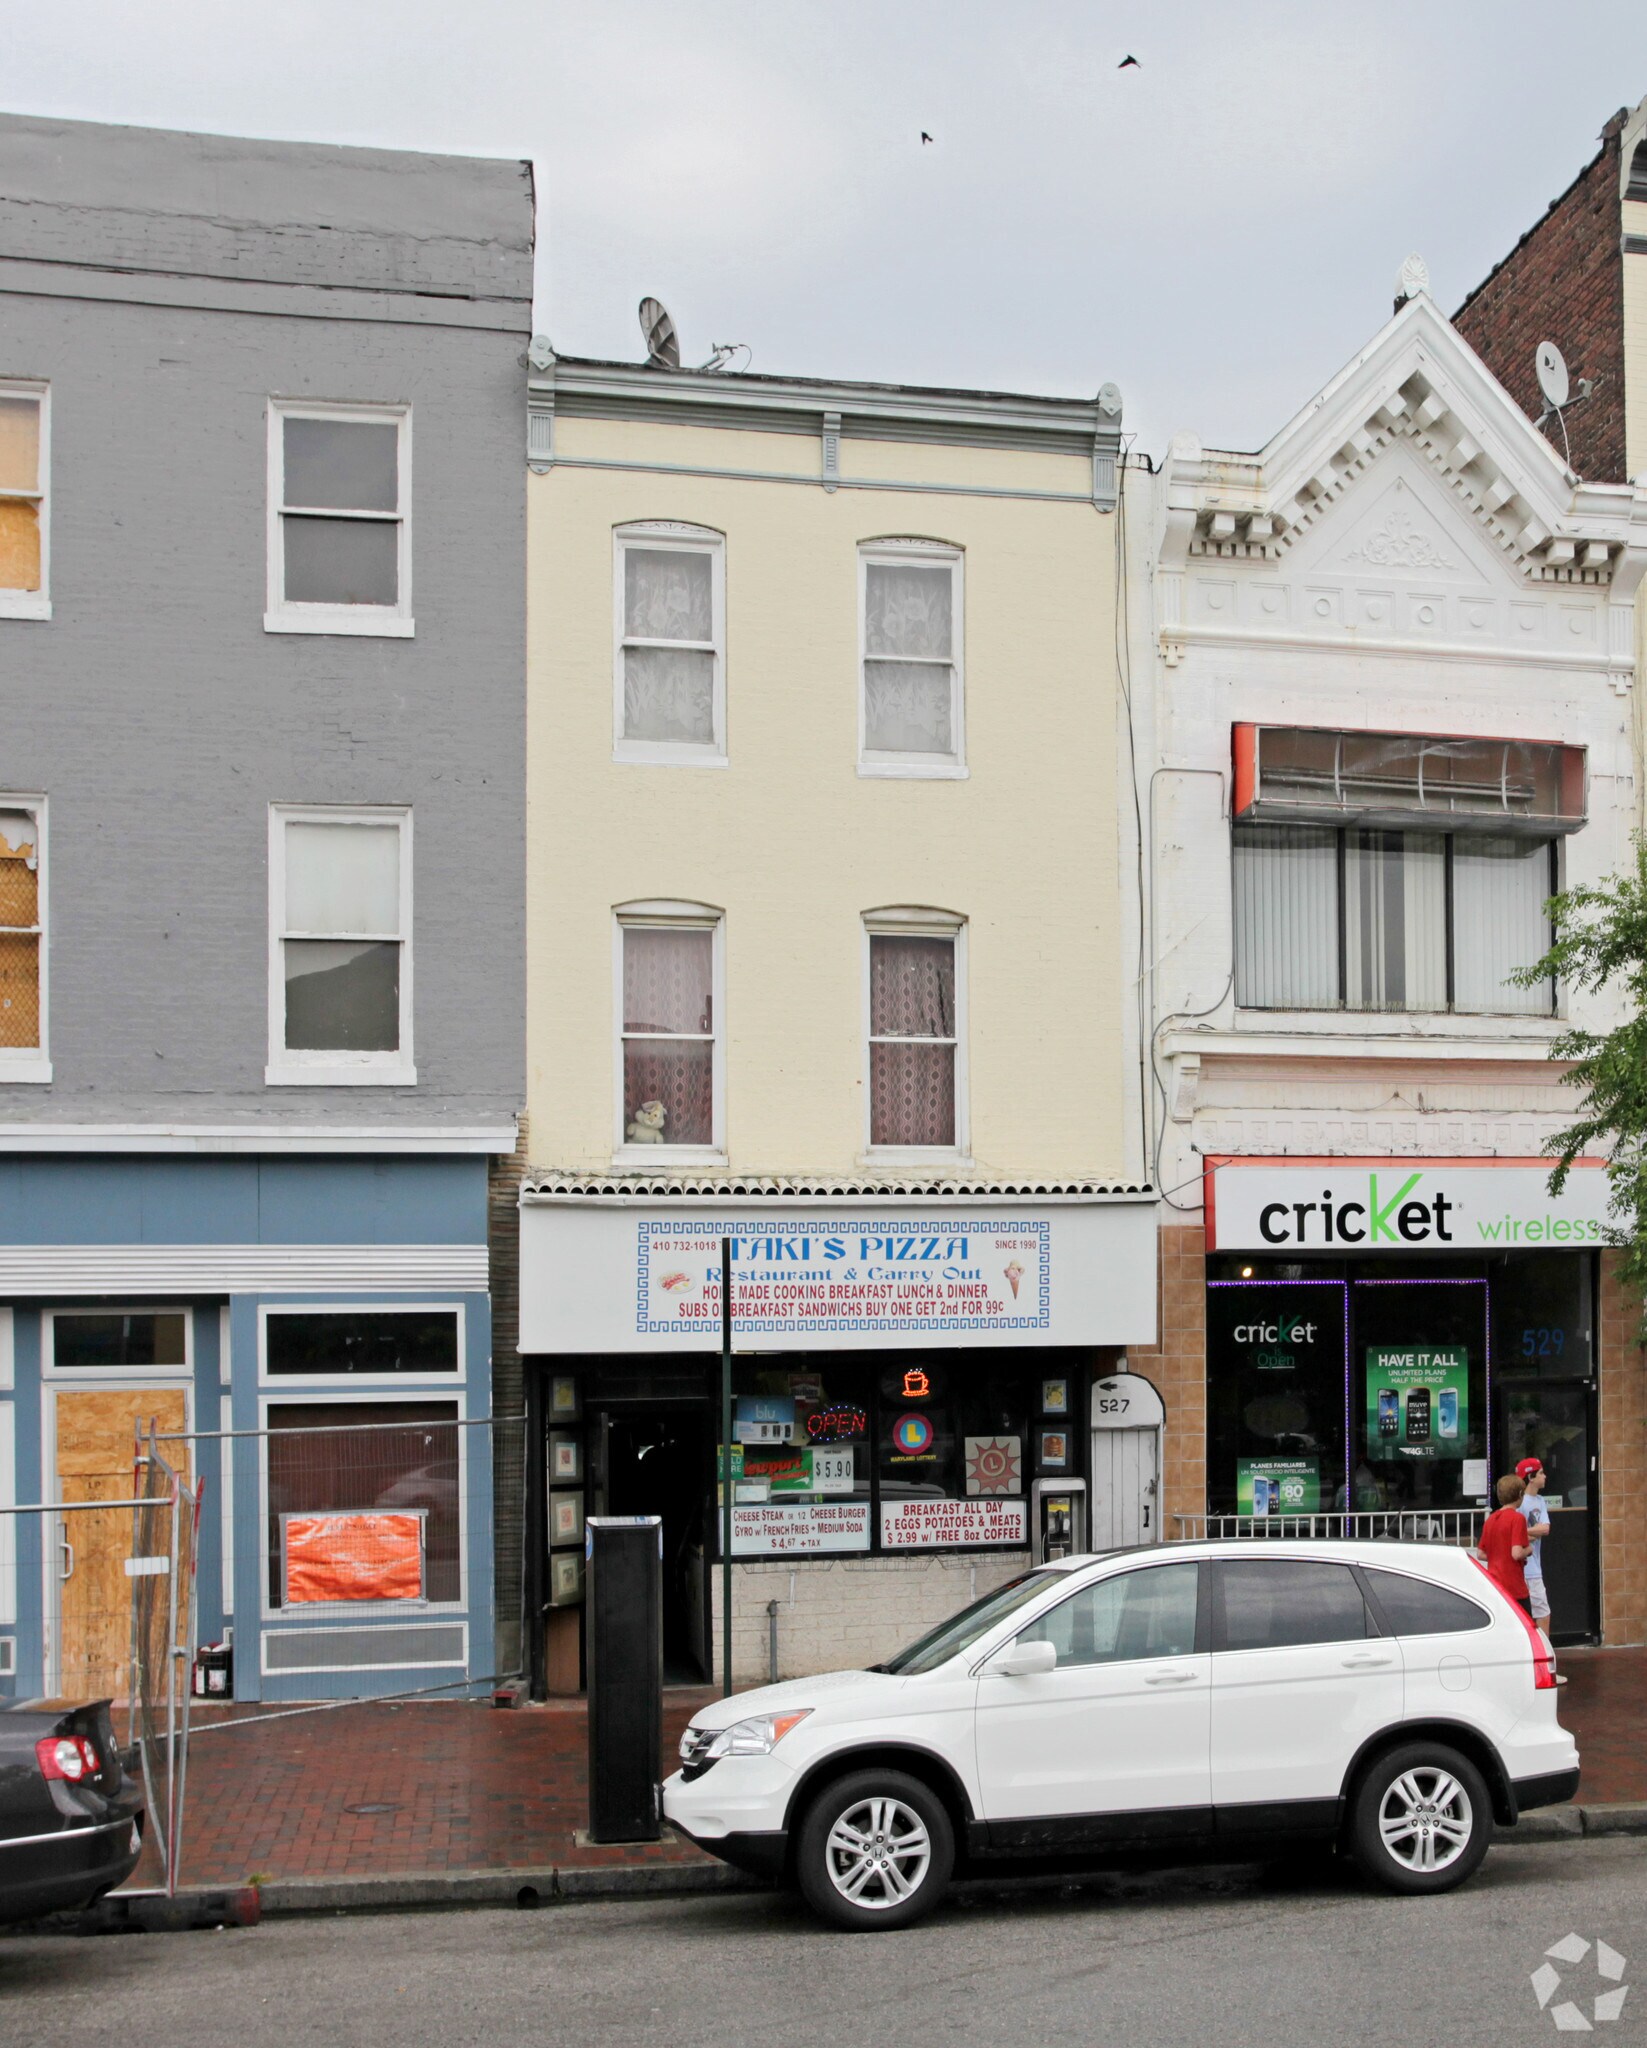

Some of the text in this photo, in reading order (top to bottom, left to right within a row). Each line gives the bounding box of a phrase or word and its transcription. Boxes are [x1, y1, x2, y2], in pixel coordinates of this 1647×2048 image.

[1476, 1214, 1600, 1241] wireless
[653, 1241, 716, 1251] 410 732-1018
[719, 1237, 968, 1261] TAKI'S PIZZA
[995, 1240, 1037, 1249] SINCE 1990
[844, 1267, 858, 1280] &
[868, 1266, 934, 1282] Carry
[942, 1266, 982, 1280] Out
[703, 1284, 988, 1299] HOE MADE COOKING BREAKFAST LUNCH & DINNER
[679, 1302, 708, 1317] SUBS
[730, 1302, 794, 1317] BREAKFAST
[797, 1302, 862, 1316] SANDWICHS
[866, 1301, 888, 1316] BUY
[891, 1301, 912, 1315] ONE
[915, 1301, 936, 1315] GET
[940, 1301, 958, 1315] 2nd
[962, 1301, 983, 1315] FOR
[1522, 1328, 1565, 1356] 529
[1257, 1353, 1295, 1369] Open
[1378, 1354, 1458, 1366] HAVE IT ALL
[755, 1405, 776, 1419] blu
[1100, 1399, 1130, 1414] 527
[807, 1413, 866, 1433] OPEN
[906, 1424, 921, 1442] L
[733, 1511, 760, 1522] CHEESE
[761, 1509, 784, 1521] STEAK
[810, 1507, 836, 1519] CHEESE
[838, 1507, 866, 1518] BURGER
[904, 1501, 1004, 1516] BREAKFAST ALL DAY
[735, 1525, 753, 1537] GYRO
[763, 1524, 789, 1536] FRENCH
[791, 1523, 809, 1535] FRIES
[818, 1522, 844, 1534] MEDIUM
[846, 1521, 863, 1533] SODA
[885, 1514, 1021, 1530] 2 EGGS POTATOES & MEATS
[921, 1531, 932, 1542] w/
[936, 1530, 959, 1541] FREE
[964, 1530, 979, 1541] 8oz
[984, 1528, 1020, 1540] COFFEE
